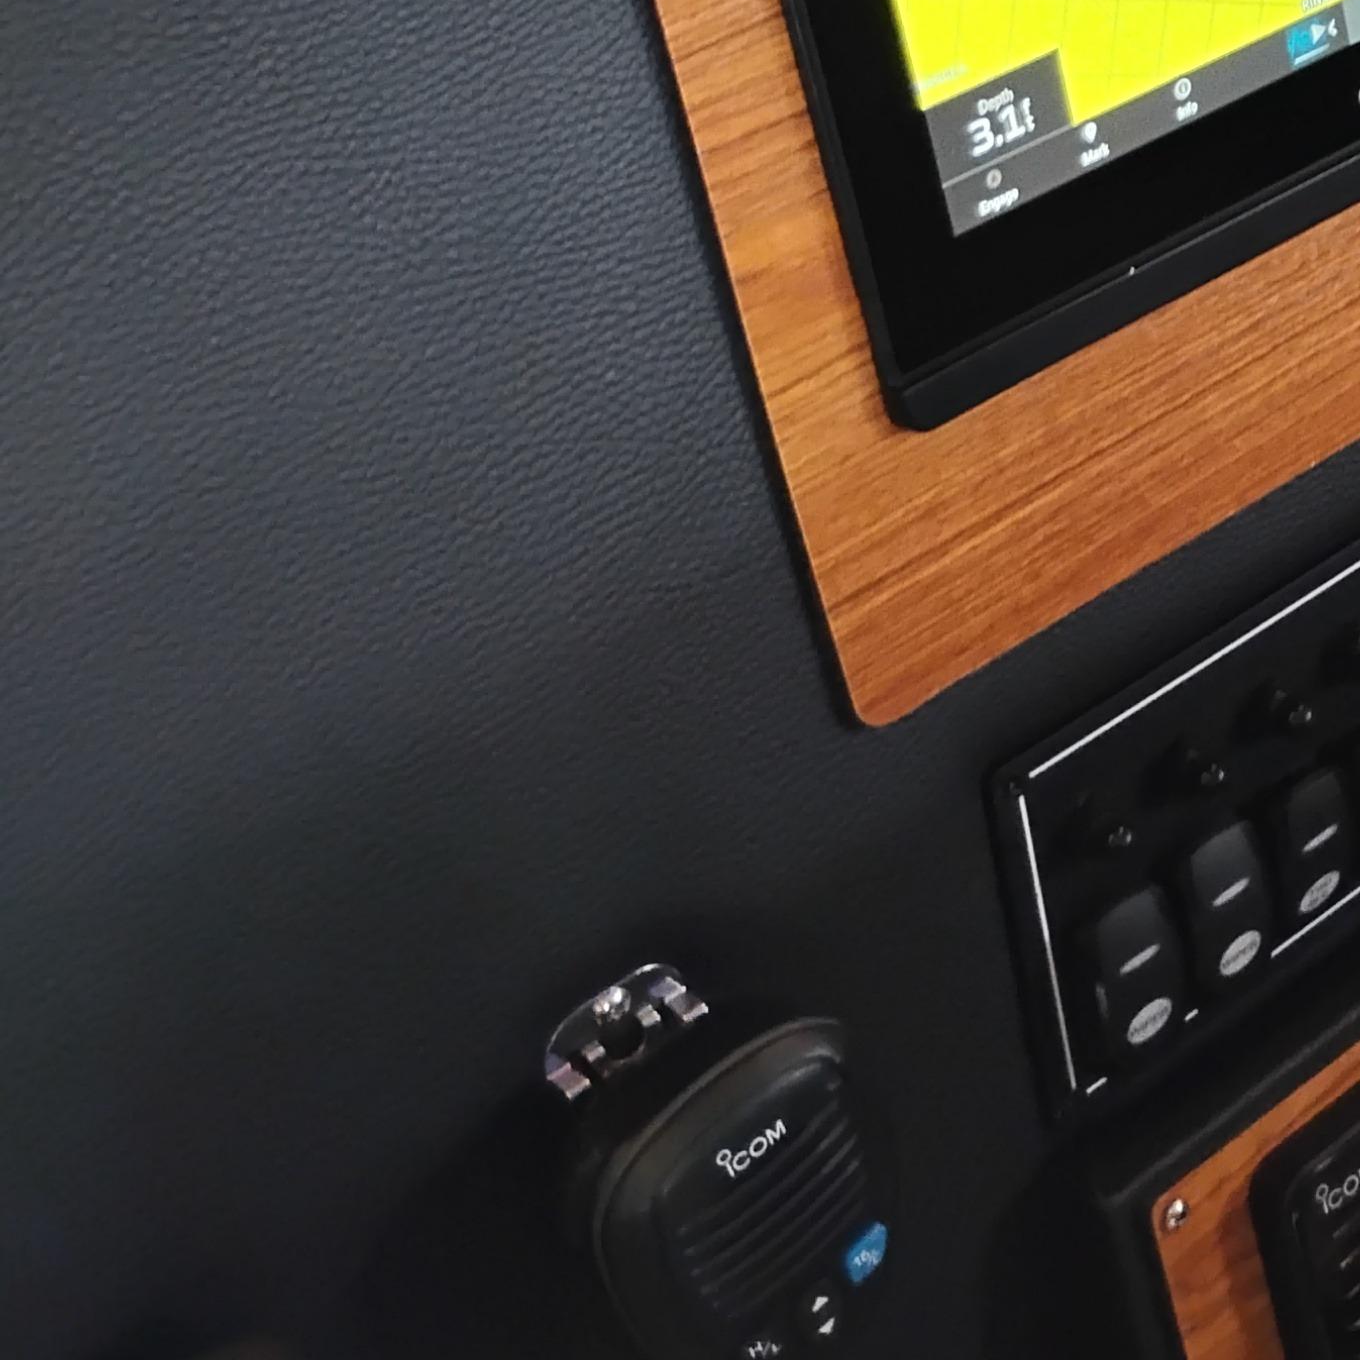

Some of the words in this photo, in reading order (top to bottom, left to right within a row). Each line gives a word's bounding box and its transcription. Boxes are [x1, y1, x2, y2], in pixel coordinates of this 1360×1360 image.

[976, 87, 1015, 116] Depth
[1080, 142, 1110, 167] Mark
[977, 187, 1020, 217] Engage
